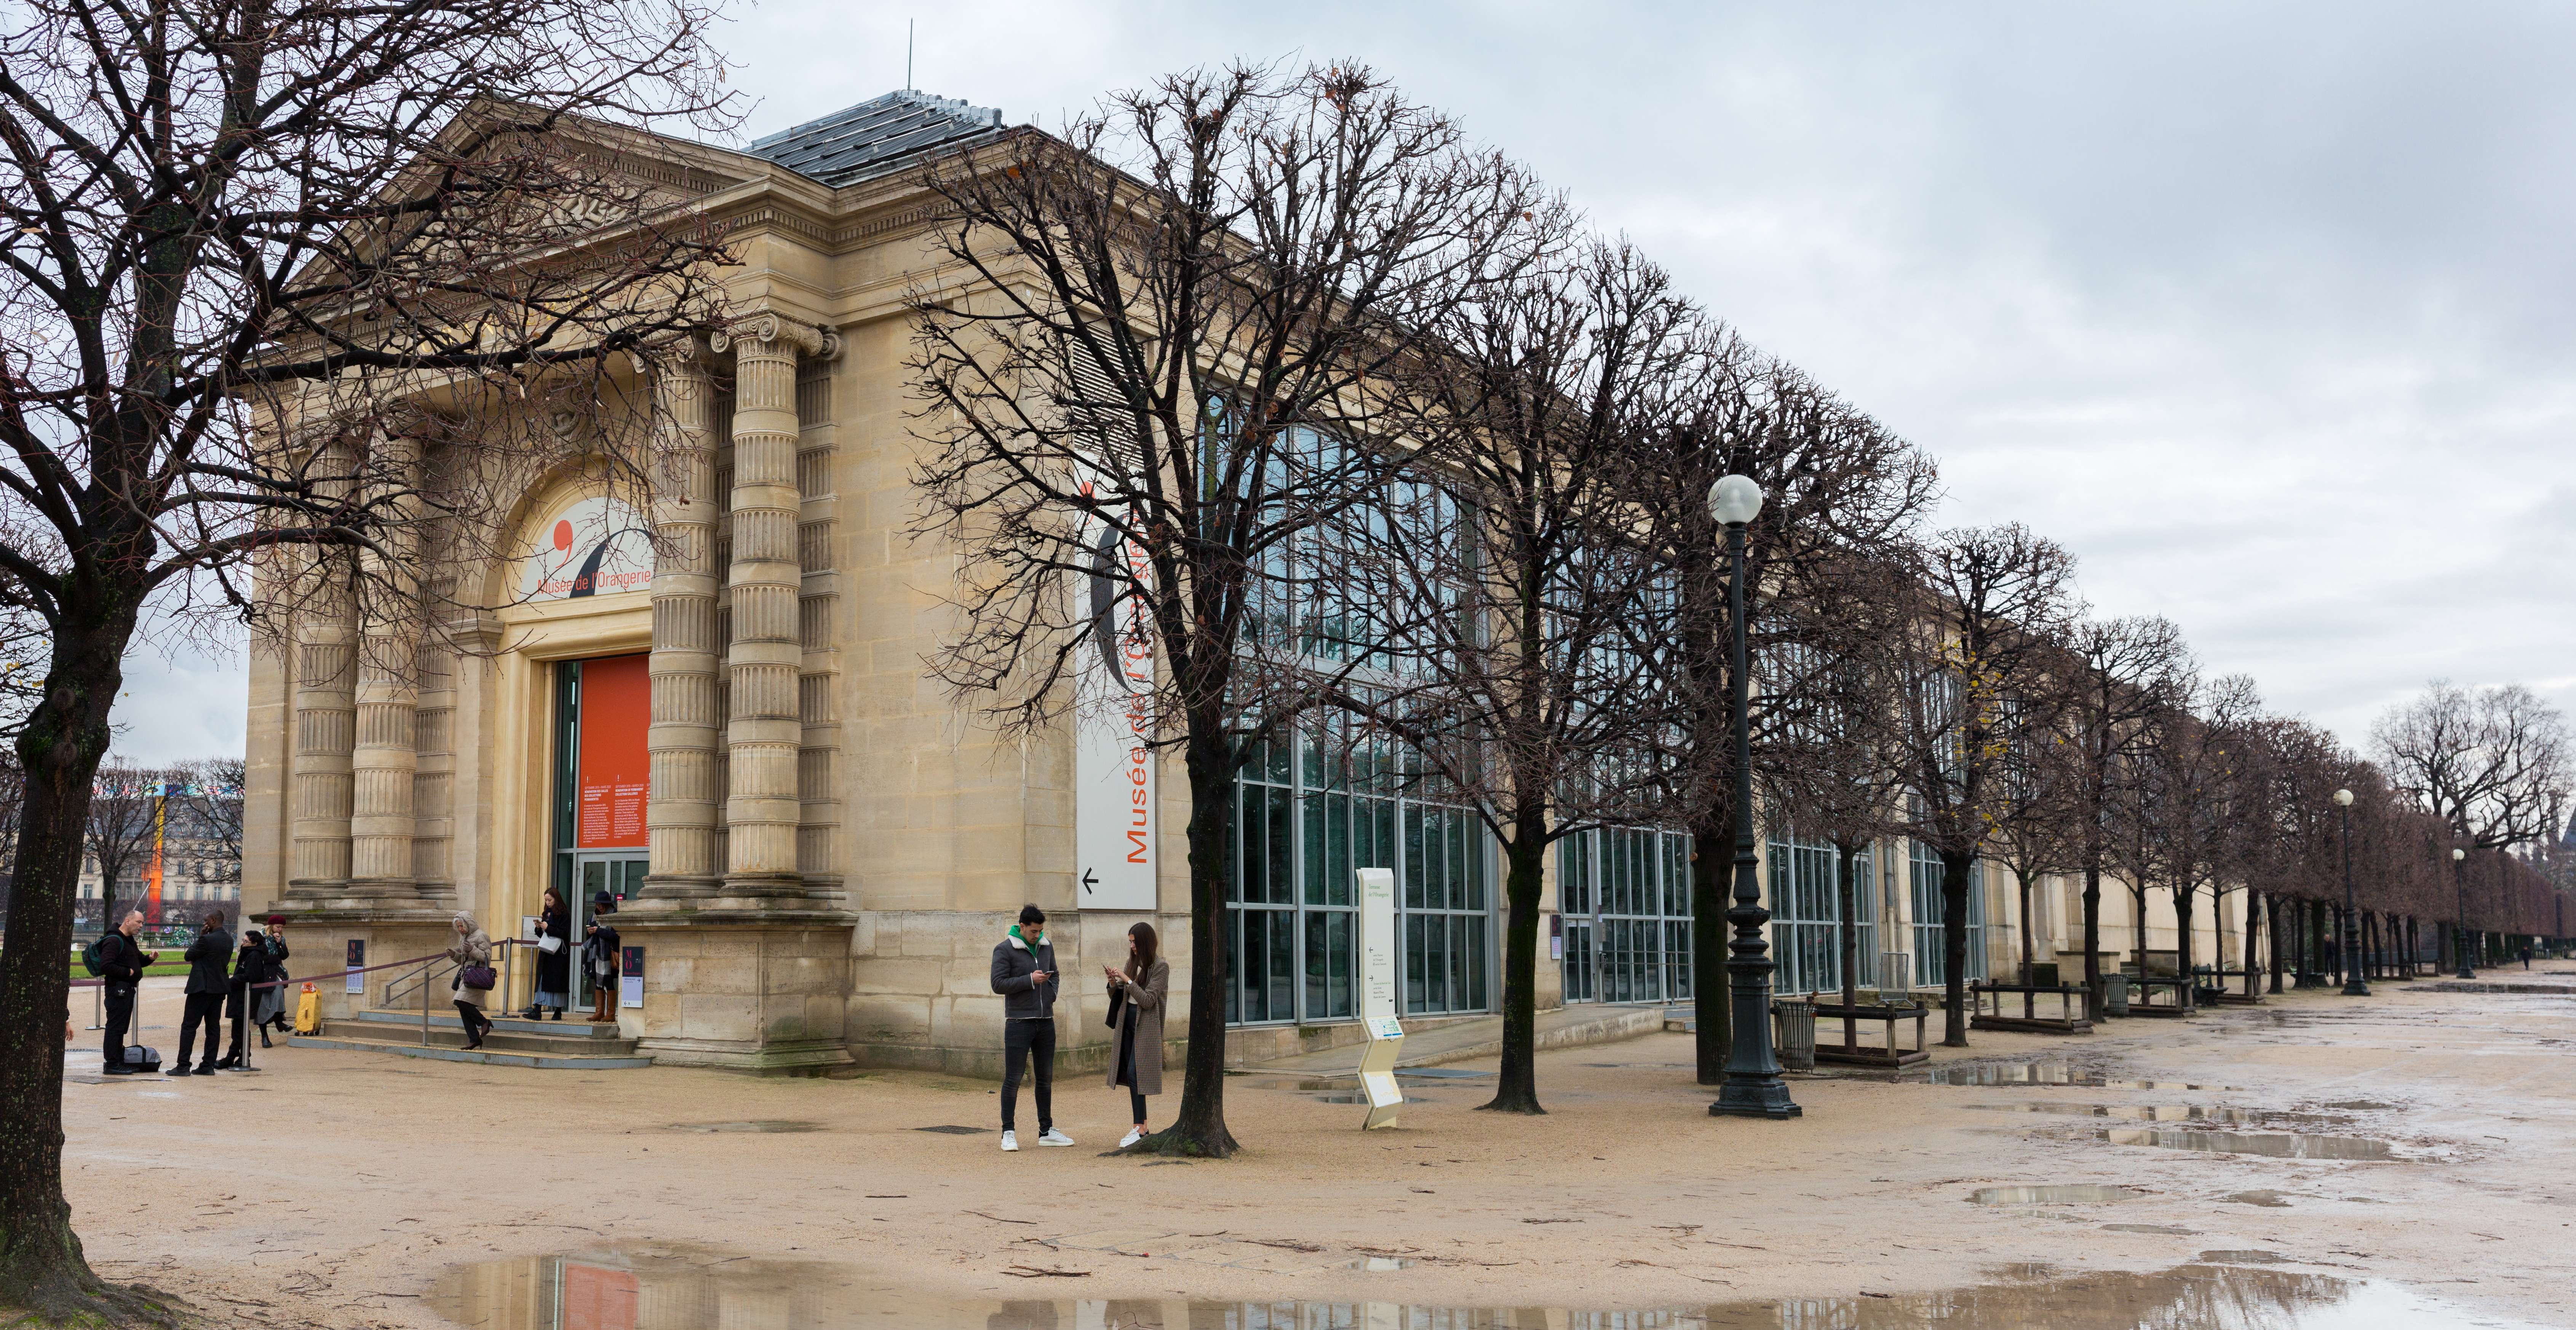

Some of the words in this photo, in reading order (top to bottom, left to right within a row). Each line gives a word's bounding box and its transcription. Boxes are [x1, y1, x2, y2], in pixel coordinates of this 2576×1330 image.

[537, 576, 572, 594] Musée
[575, 575, 588, 591] de
[592, 566, 650, 589] l'Orangerie
[1126, 693, 1145, 733] de
[1127, 746, 1147, 863] Musée
